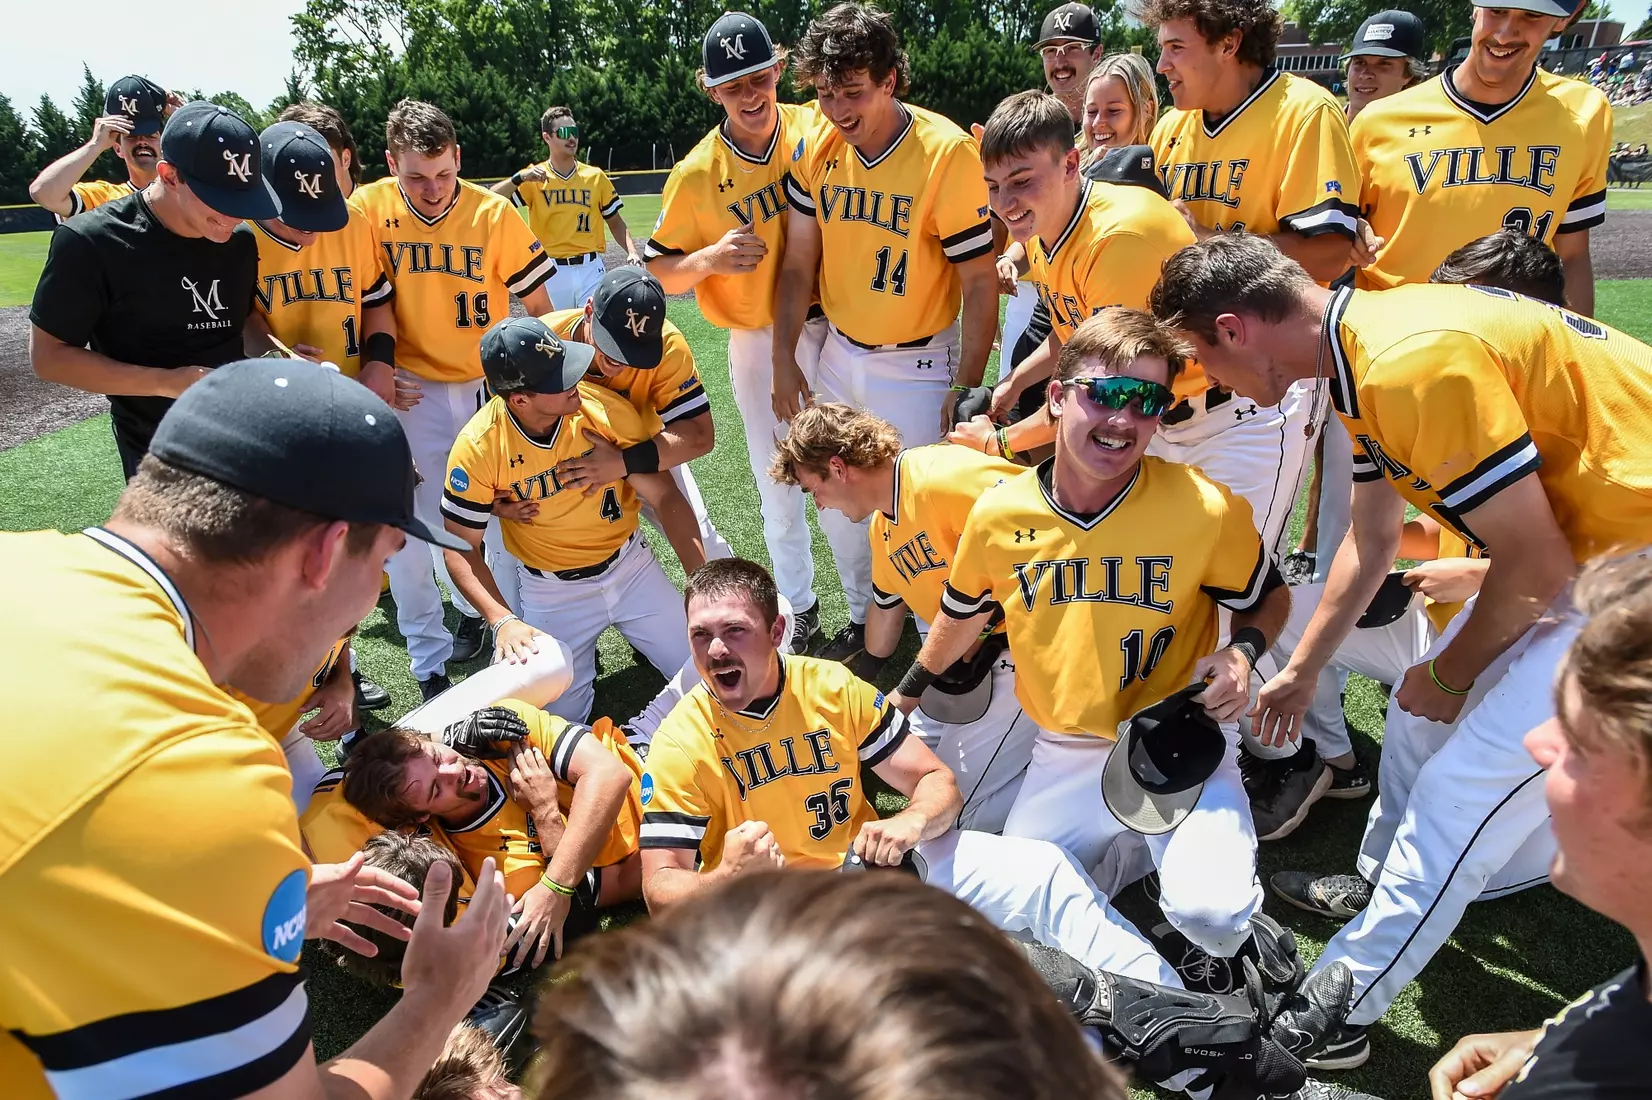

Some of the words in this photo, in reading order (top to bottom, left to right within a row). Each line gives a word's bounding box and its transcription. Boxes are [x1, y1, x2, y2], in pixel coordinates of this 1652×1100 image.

[720, 34, 749, 61] M
[118, 94, 138, 116] M
[223, 149, 253, 183] M
[294, 170, 323, 199] M
[1157, 158, 1250, 209] VILLE
[1403, 145, 1561, 197] VILLE
[540, 188, 592, 208] VILLE
[819, 183, 914, 239] VILLE
[576, 212, 591, 233] 11
[380, 242, 486, 284] VILLE
[870, 246, 909, 297] 14
[254, 266, 356, 314] VILLE
[454, 291, 491, 328] 19
[187, 319, 233, 330] BASEBALL
[599, 486, 624, 524] 4
[1012, 555, 1173, 614] VILLE
[1119, 624, 1177, 692] 10
[721, 728, 840, 801] VILLE
[804, 778, 853, 841] 35
